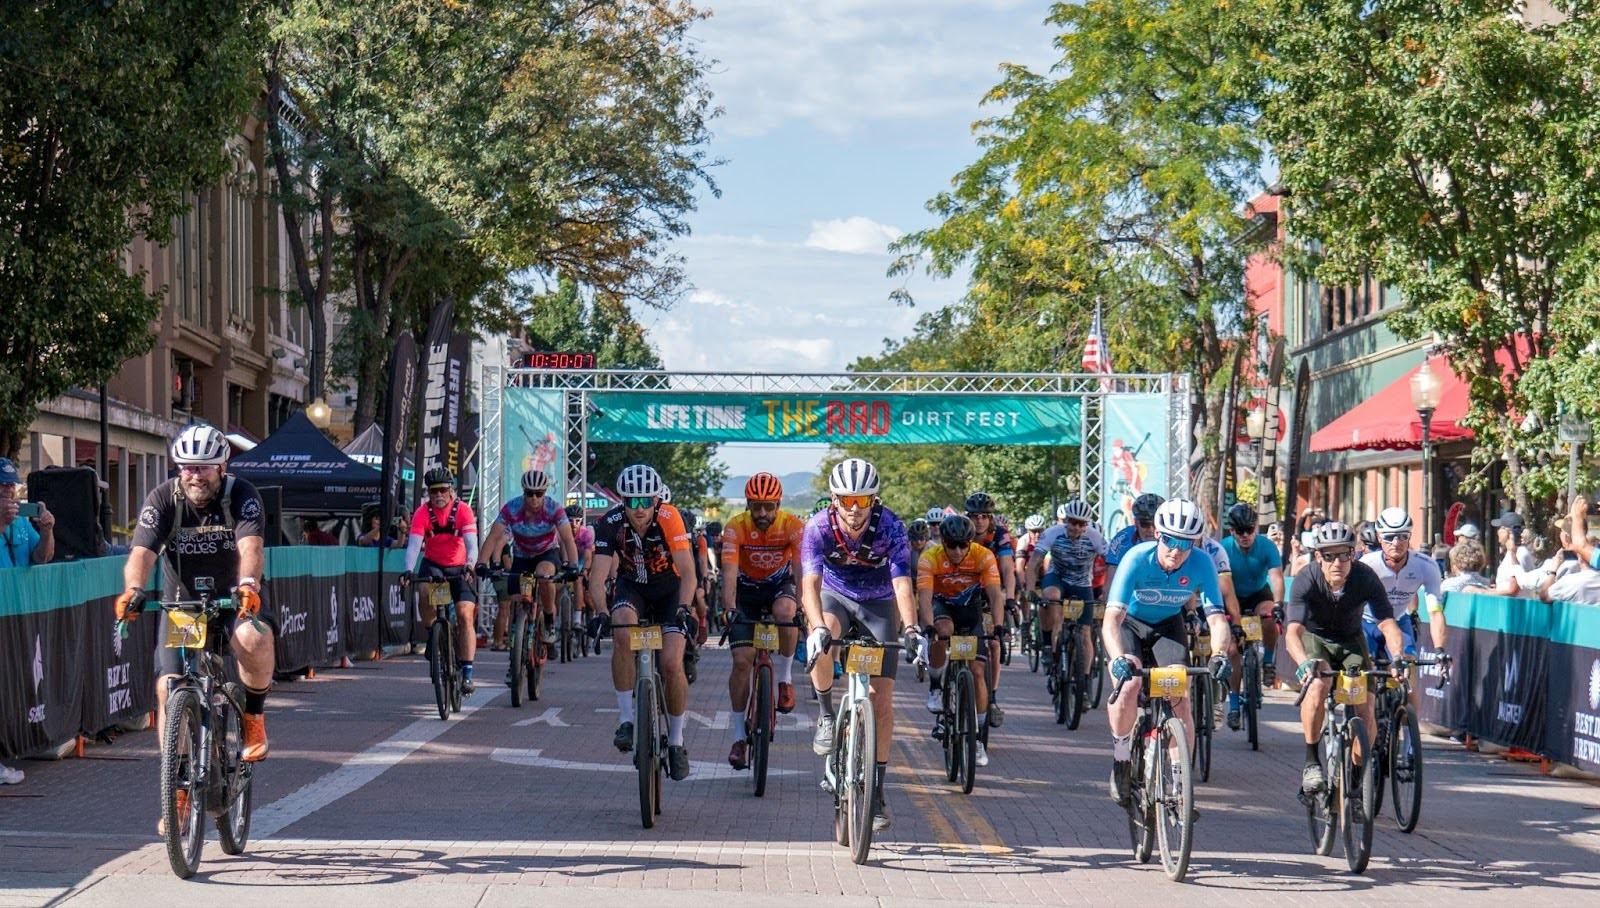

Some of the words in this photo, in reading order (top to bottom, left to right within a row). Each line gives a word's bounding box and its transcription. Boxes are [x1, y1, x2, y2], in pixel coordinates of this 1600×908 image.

[763, 400, 818, 437] THE
[825, 401, 890, 436] RAD
[902, 411, 954, 426] DIRT
[965, 411, 1021, 428] FEST
[850, 653, 880, 664] 1091
[1574, 711, 1594, 736] BEST
